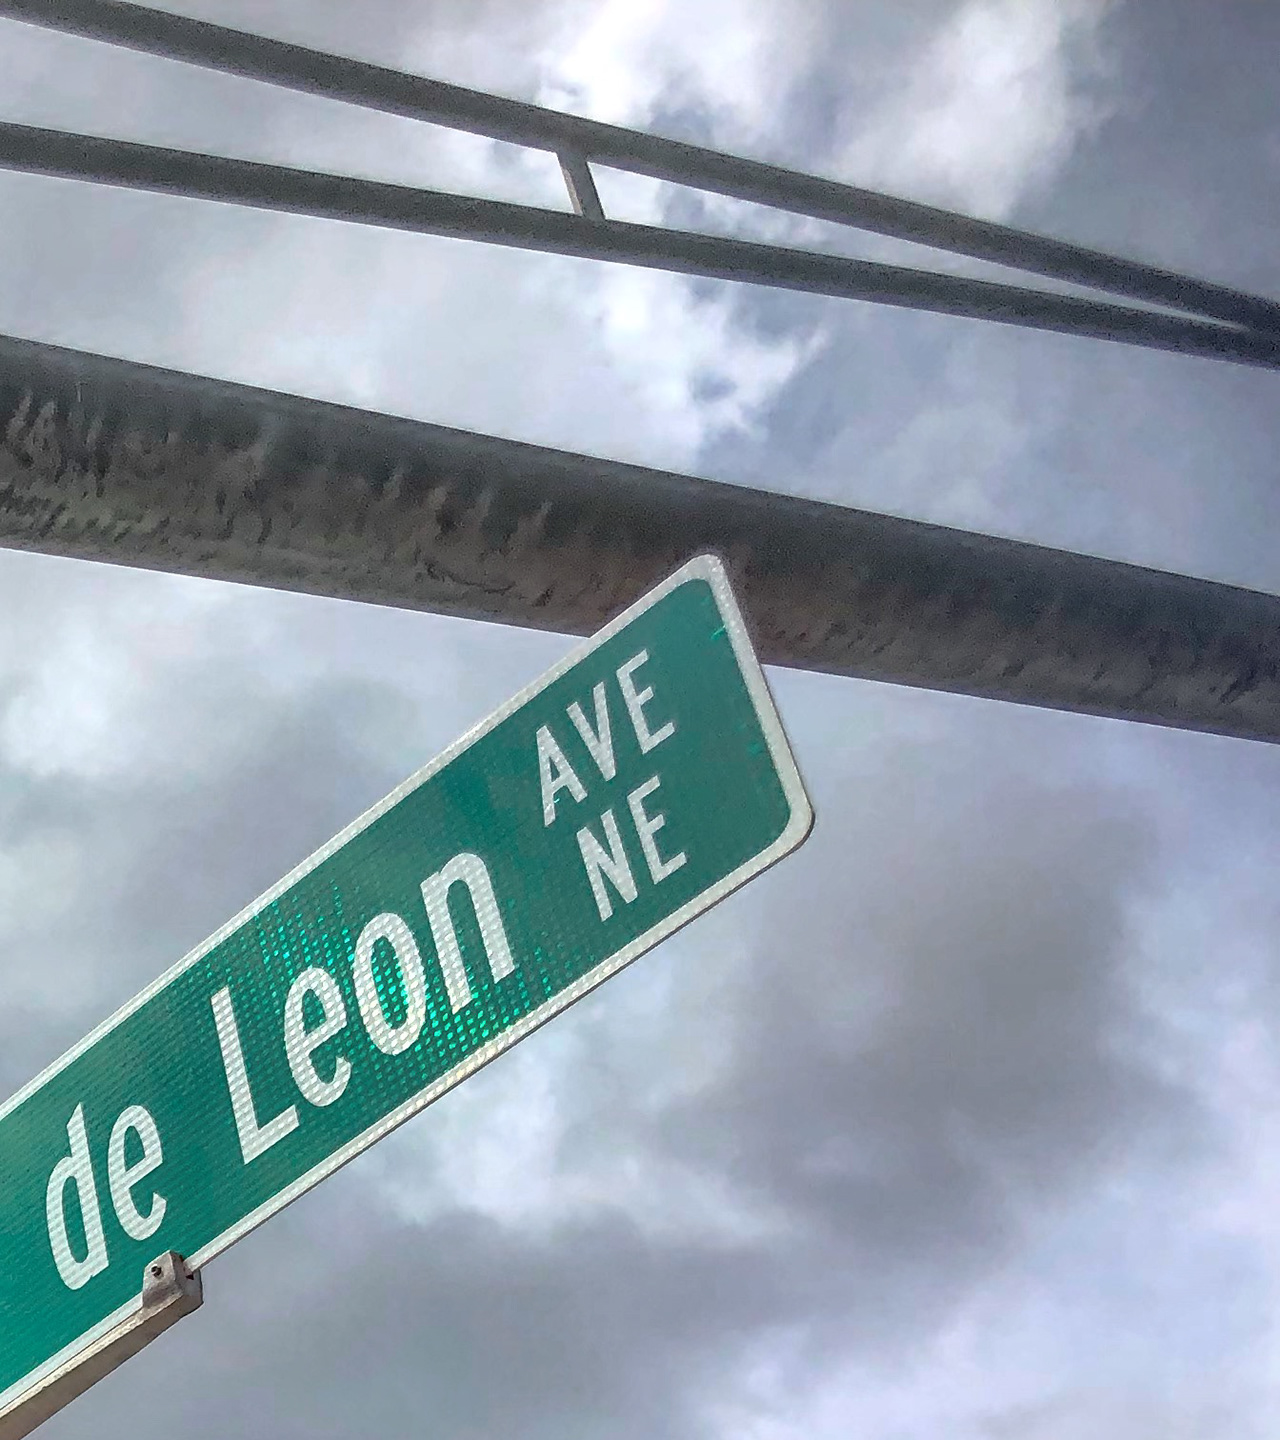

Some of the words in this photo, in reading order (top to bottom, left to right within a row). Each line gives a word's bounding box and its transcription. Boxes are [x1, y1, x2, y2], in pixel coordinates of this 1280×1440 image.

[536, 649, 676, 827] AVE
[576, 775, 688, 922] NE
[45, 1102, 168, 1291] de
[210, 852, 517, 1165] Leon
